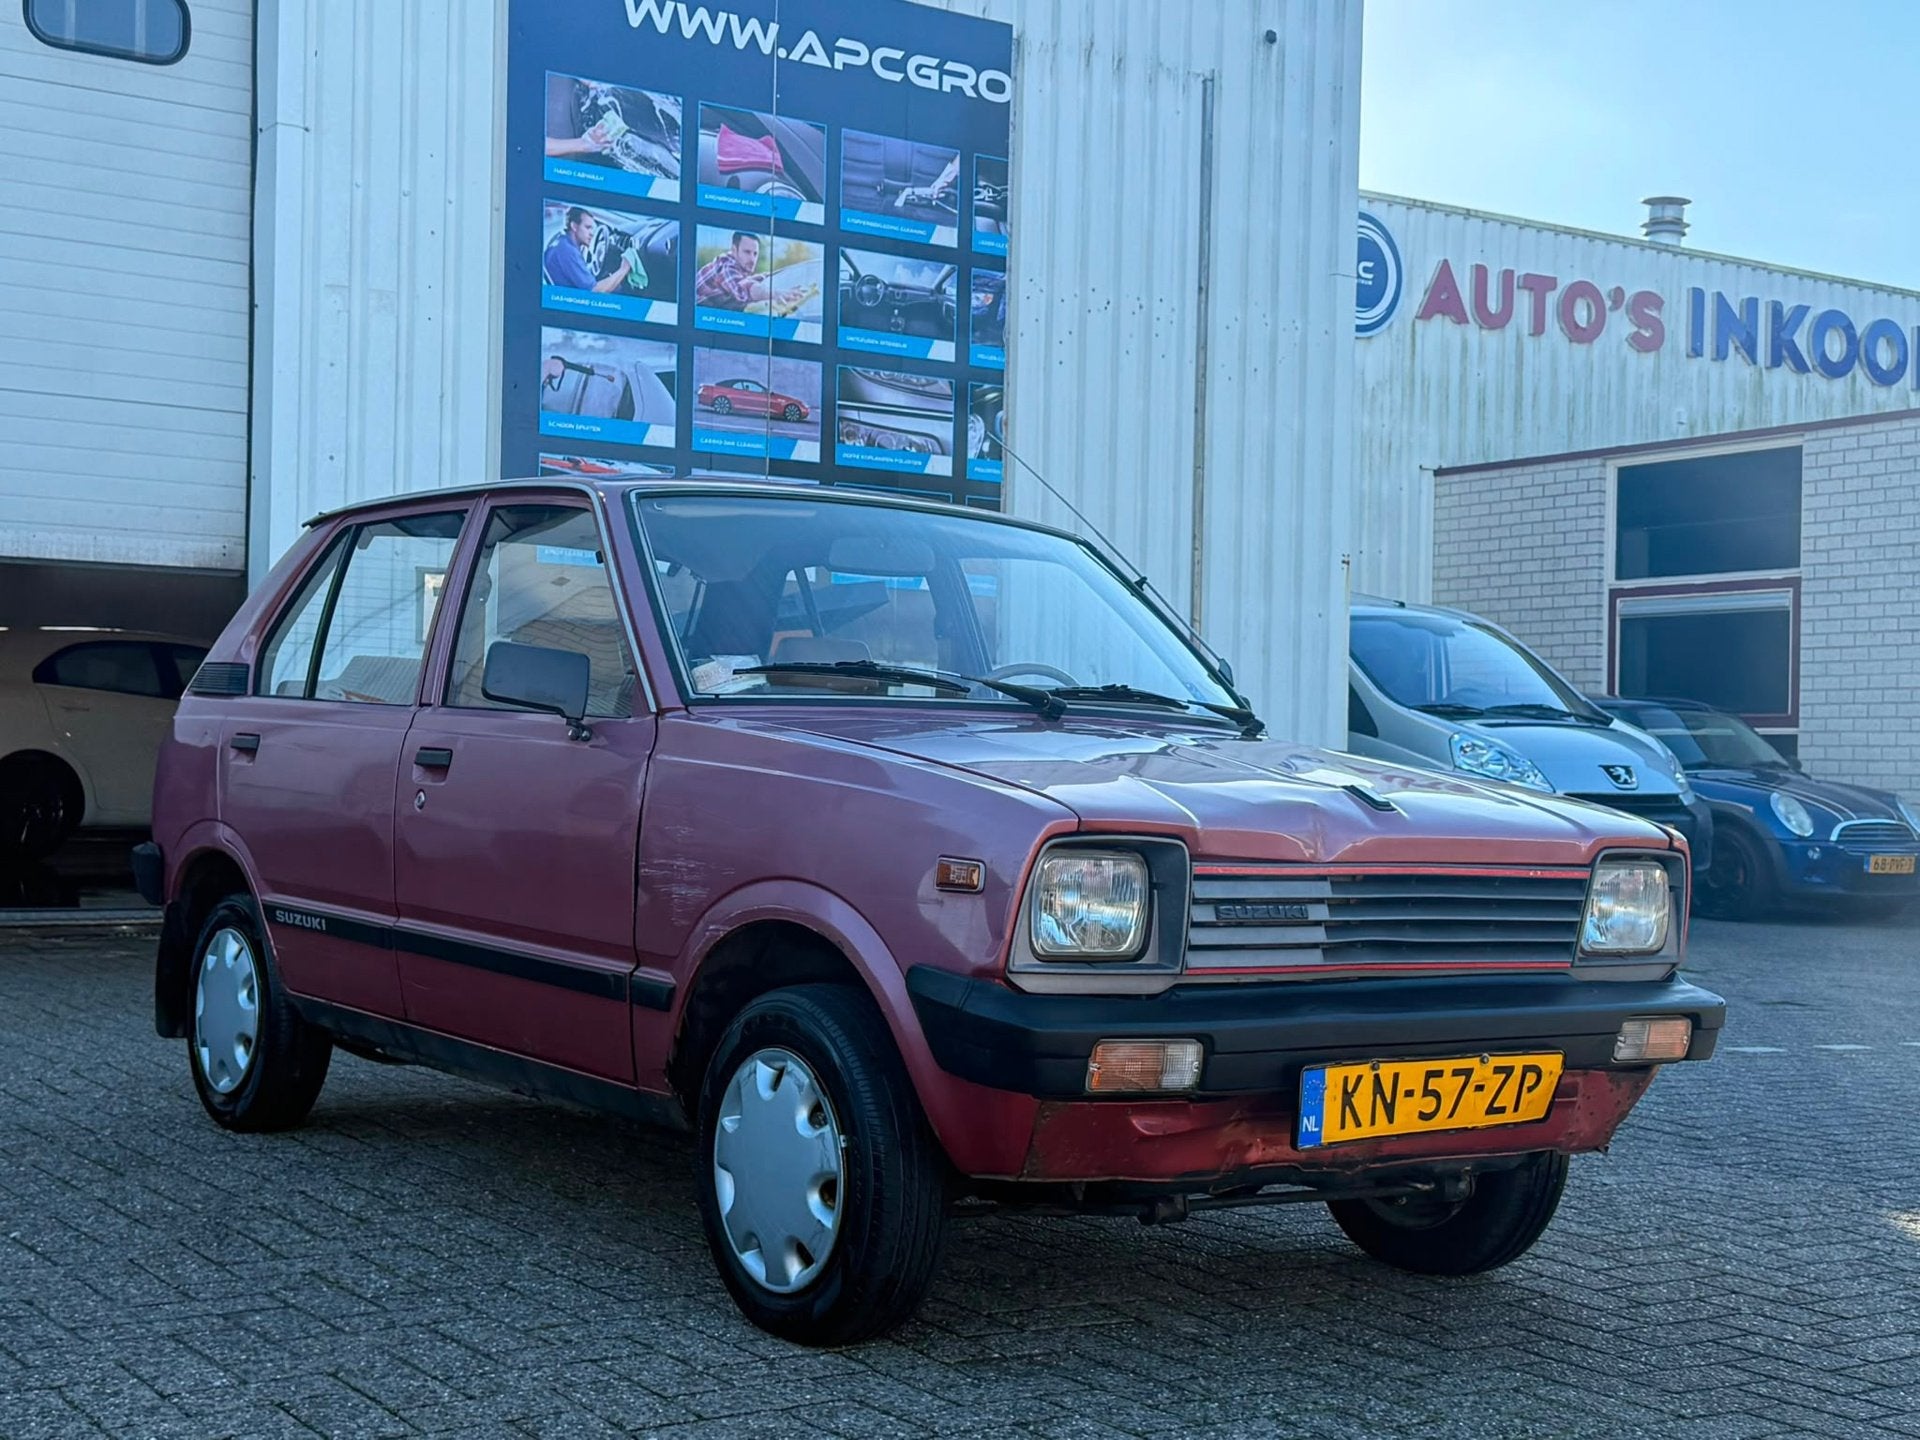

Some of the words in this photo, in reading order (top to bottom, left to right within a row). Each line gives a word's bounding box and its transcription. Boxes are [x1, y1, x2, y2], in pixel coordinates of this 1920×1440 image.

[624, 0, 1013, 103] WWW.APCGRO
[275, 910, 327, 931] SUZUKI
[1216, 904, 1309, 920] SUZUKI
[1302, 1115, 1320, 1133] NL
[1339, 1063, 1543, 1130] KN-57-ZP
